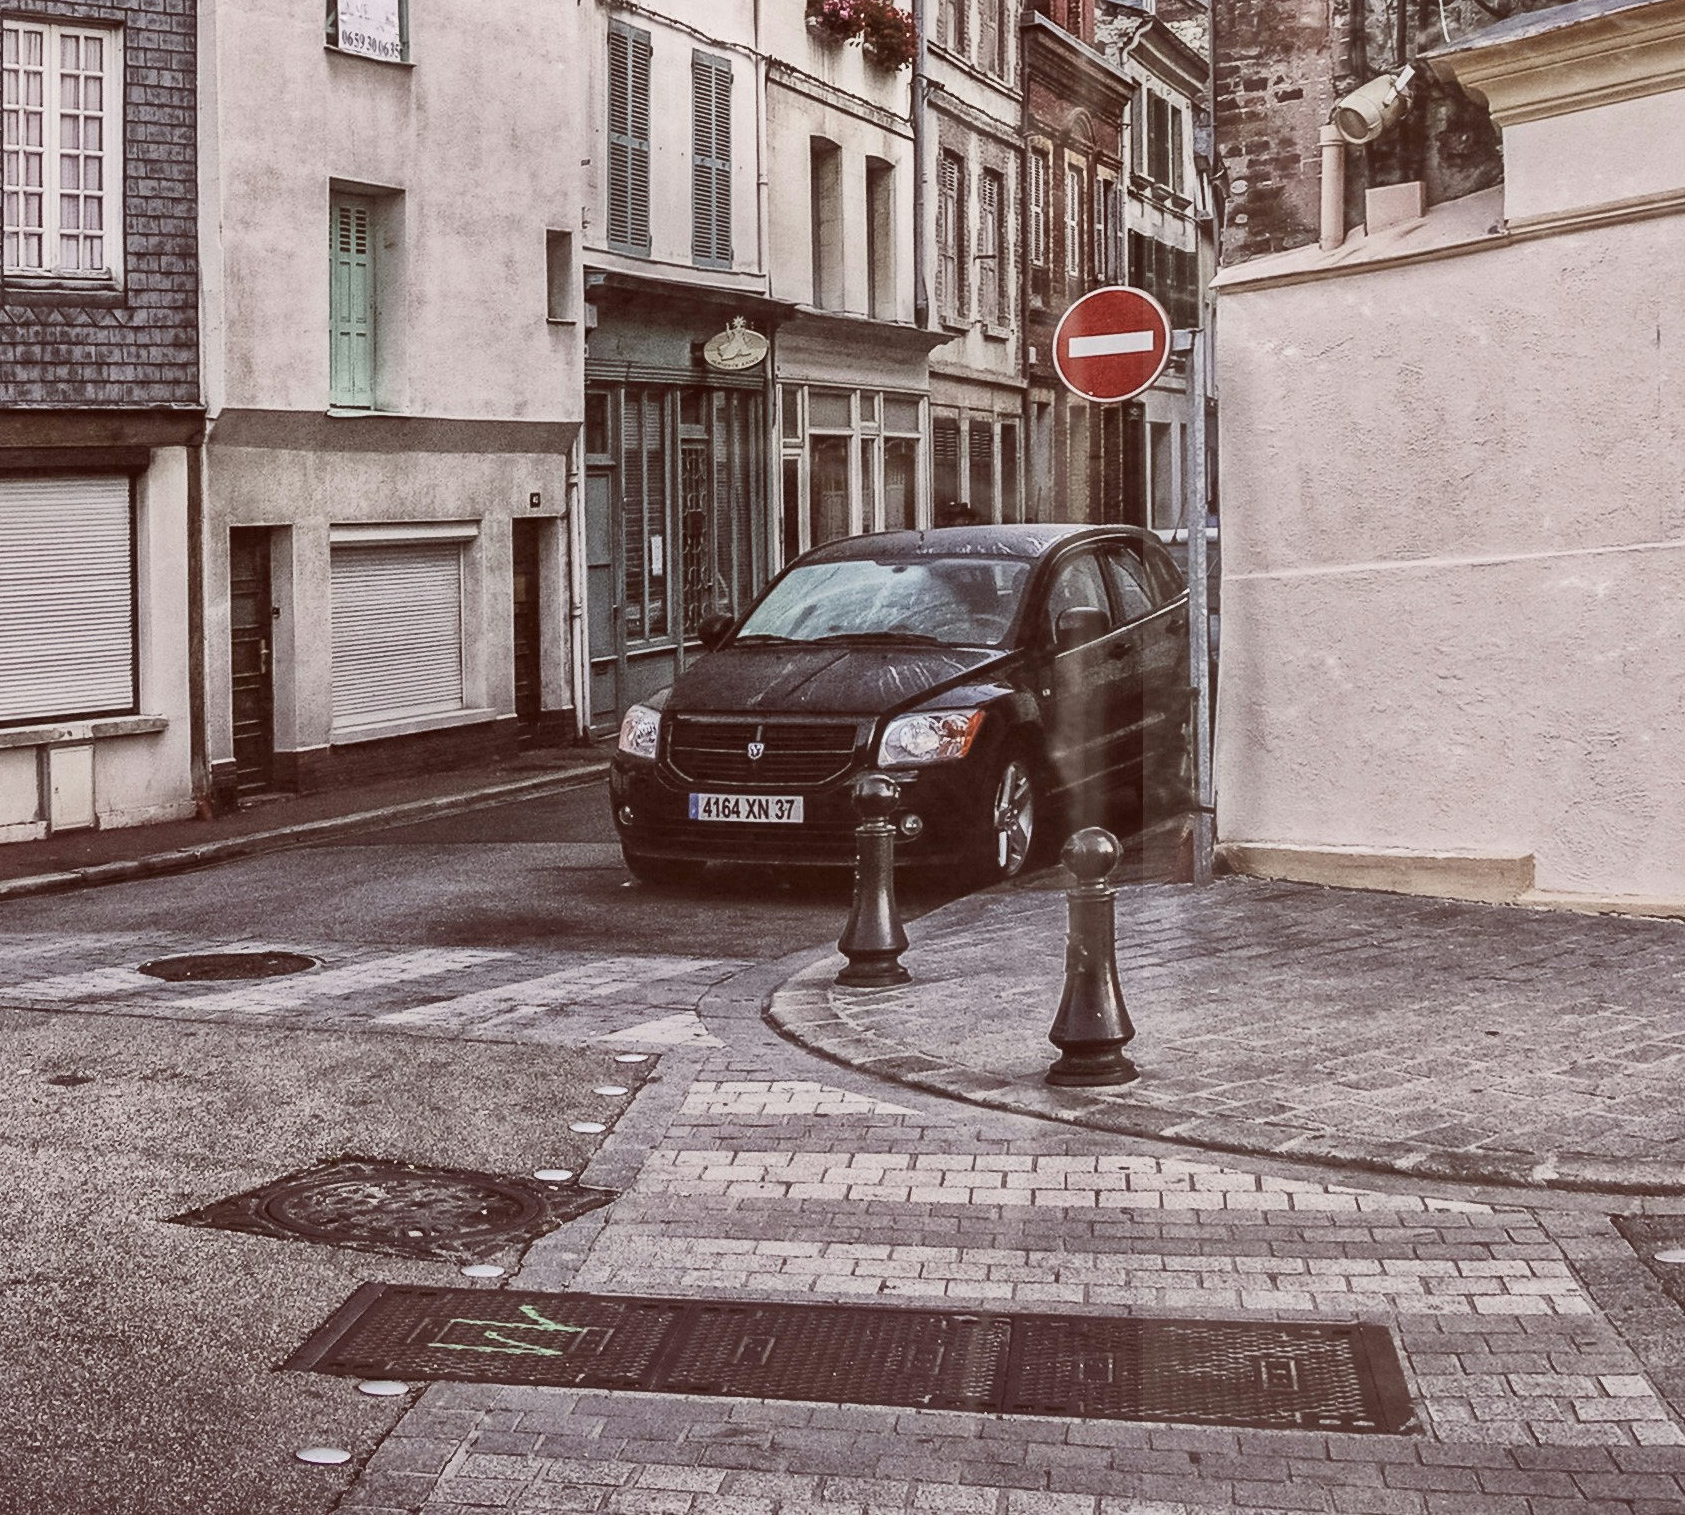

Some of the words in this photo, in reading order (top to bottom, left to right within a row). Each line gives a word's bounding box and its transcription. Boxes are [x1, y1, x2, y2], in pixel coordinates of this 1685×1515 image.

[702, 796, 741, 819] 4164
[745, 798, 770, 820] XN
[774, 798, 795, 820] 37
